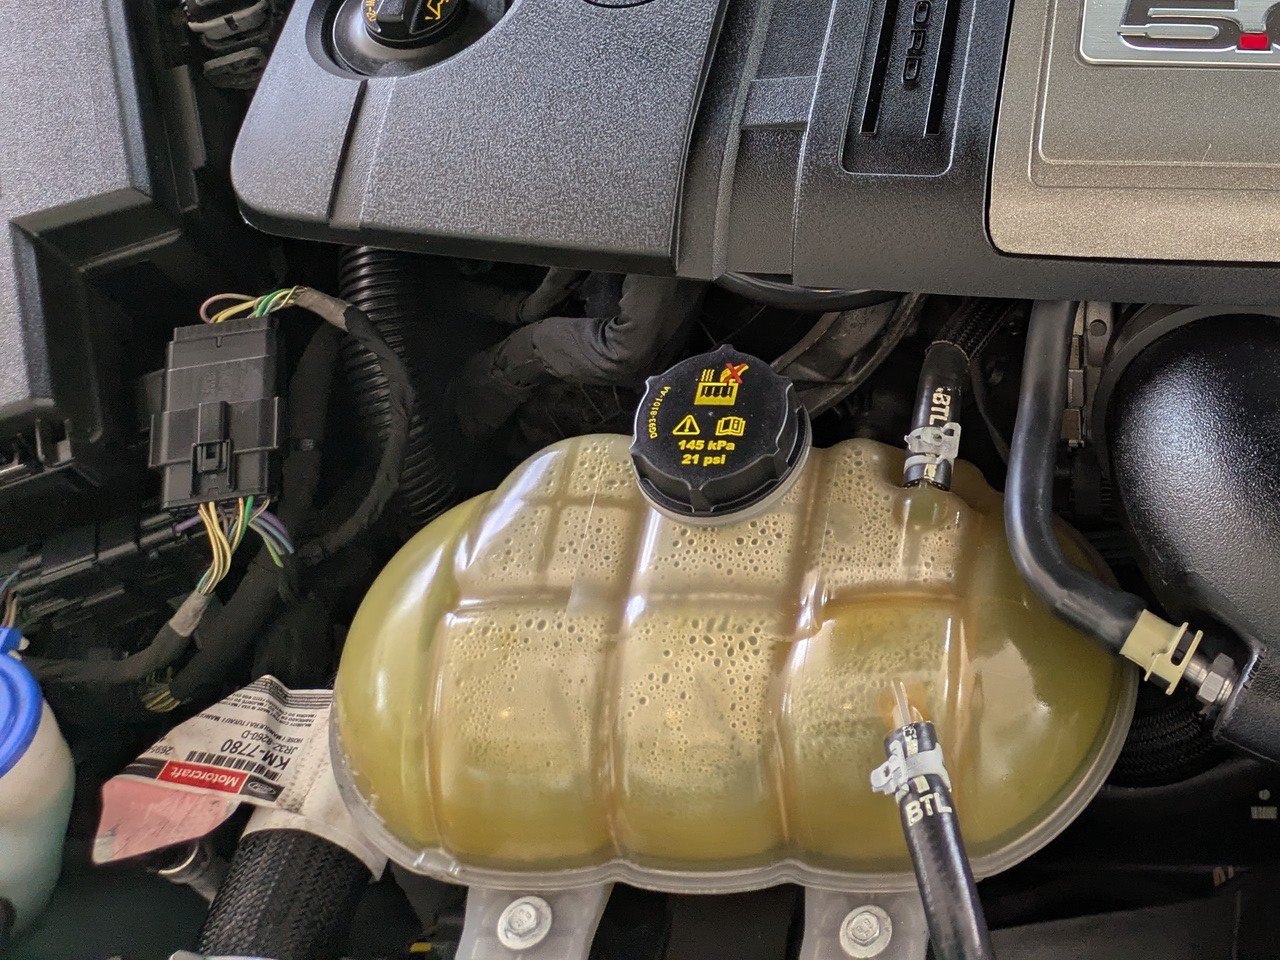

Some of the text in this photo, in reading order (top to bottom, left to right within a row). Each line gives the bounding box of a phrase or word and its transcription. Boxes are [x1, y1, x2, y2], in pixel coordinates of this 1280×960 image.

[649, 385, 672, 440] DG93-8101-AA
[929, 392, 951, 426] BTL
[678, 439, 735, 451] 145 kPa
[681, 453, 726, 467] 21 psi
[220, 738, 291, 771] KM-7780
[241, 730, 298, 755] JR3Z-8260-D
[170, 766, 240, 788] Motorcraft
[905, 792, 953, 827] BTL
